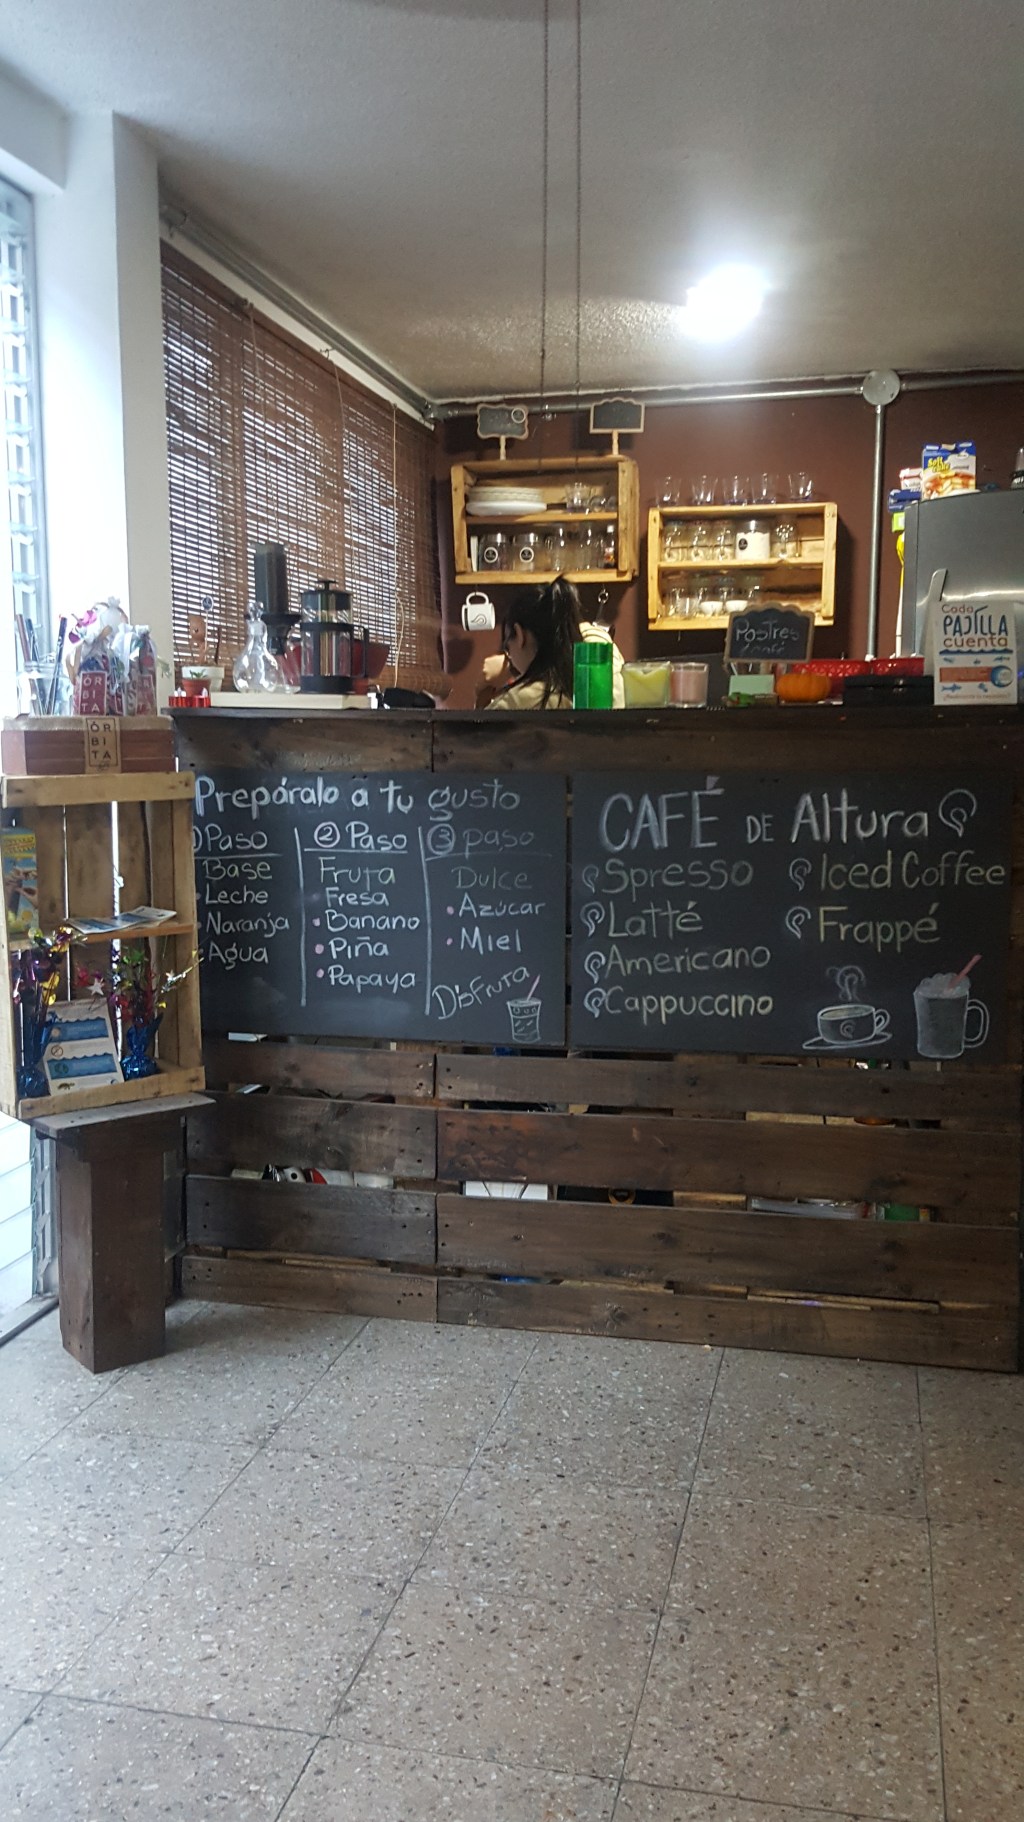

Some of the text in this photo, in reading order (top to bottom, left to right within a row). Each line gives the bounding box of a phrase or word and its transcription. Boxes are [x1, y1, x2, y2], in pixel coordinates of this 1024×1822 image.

[943, 635, 1008, 648] cuenta
[194, 775, 521, 821] Prepáralo a tu gusto
[602, 775, 929, 853] CAFÉ DE Altura
[204, 823, 268, 852] Paso
[345, 821, 408, 850] Paso
[202, 858, 272, 880] Base
[318, 856, 396, 891] Fruta
[451, 865, 532, 890] Dulce
[600, 857, 754, 901] Spresso
[820, 849, 1006, 891] Iced Coffee
[205, 883, 269, 905] Leche
[325, 886, 390, 907] Fresa
[205, 911, 290, 938] Naranja
[324, 909, 420, 932] Banano
[607, 901, 704, 940] Latté
[818, 902, 941, 953] Frappé
[328, 936, 389, 960] Piña
[460, 926, 522, 955] Miel
[208, 941, 269, 970] Agua
[603, 944, 771, 979] Americano
[327, 964, 416, 994] Papaya
[604, 985, 774, 1026] Cappuccino
